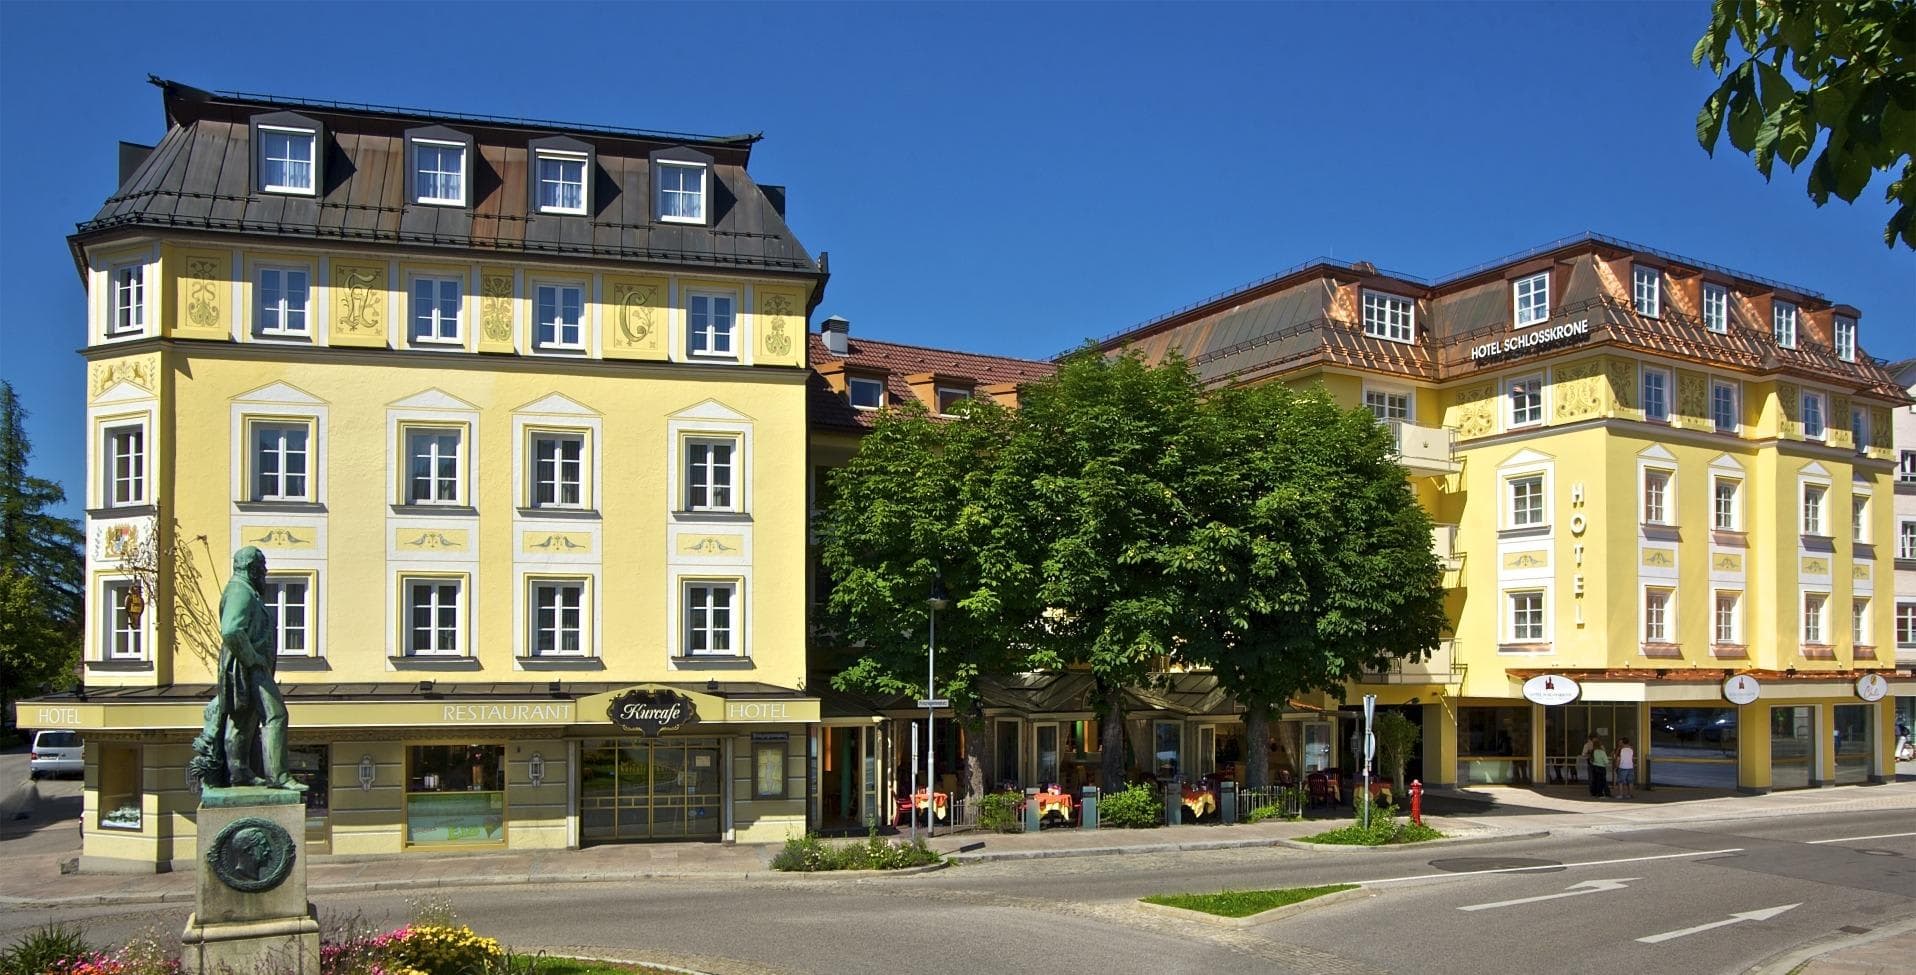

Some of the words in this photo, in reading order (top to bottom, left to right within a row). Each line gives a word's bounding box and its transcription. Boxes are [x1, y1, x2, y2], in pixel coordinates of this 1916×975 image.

[1471, 341, 1502, 360] HOTEL
[1503, 319, 1589, 352] SCHLOSSKRONE
[1569, 482, 1587, 625] HOTEL
[39, 707, 82, 724] HOTEL
[443, 704, 569, 721] RESTAURANT
[619, 702, 681, 725] Kurcafe
[729, 703, 791, 719] HOTEL
